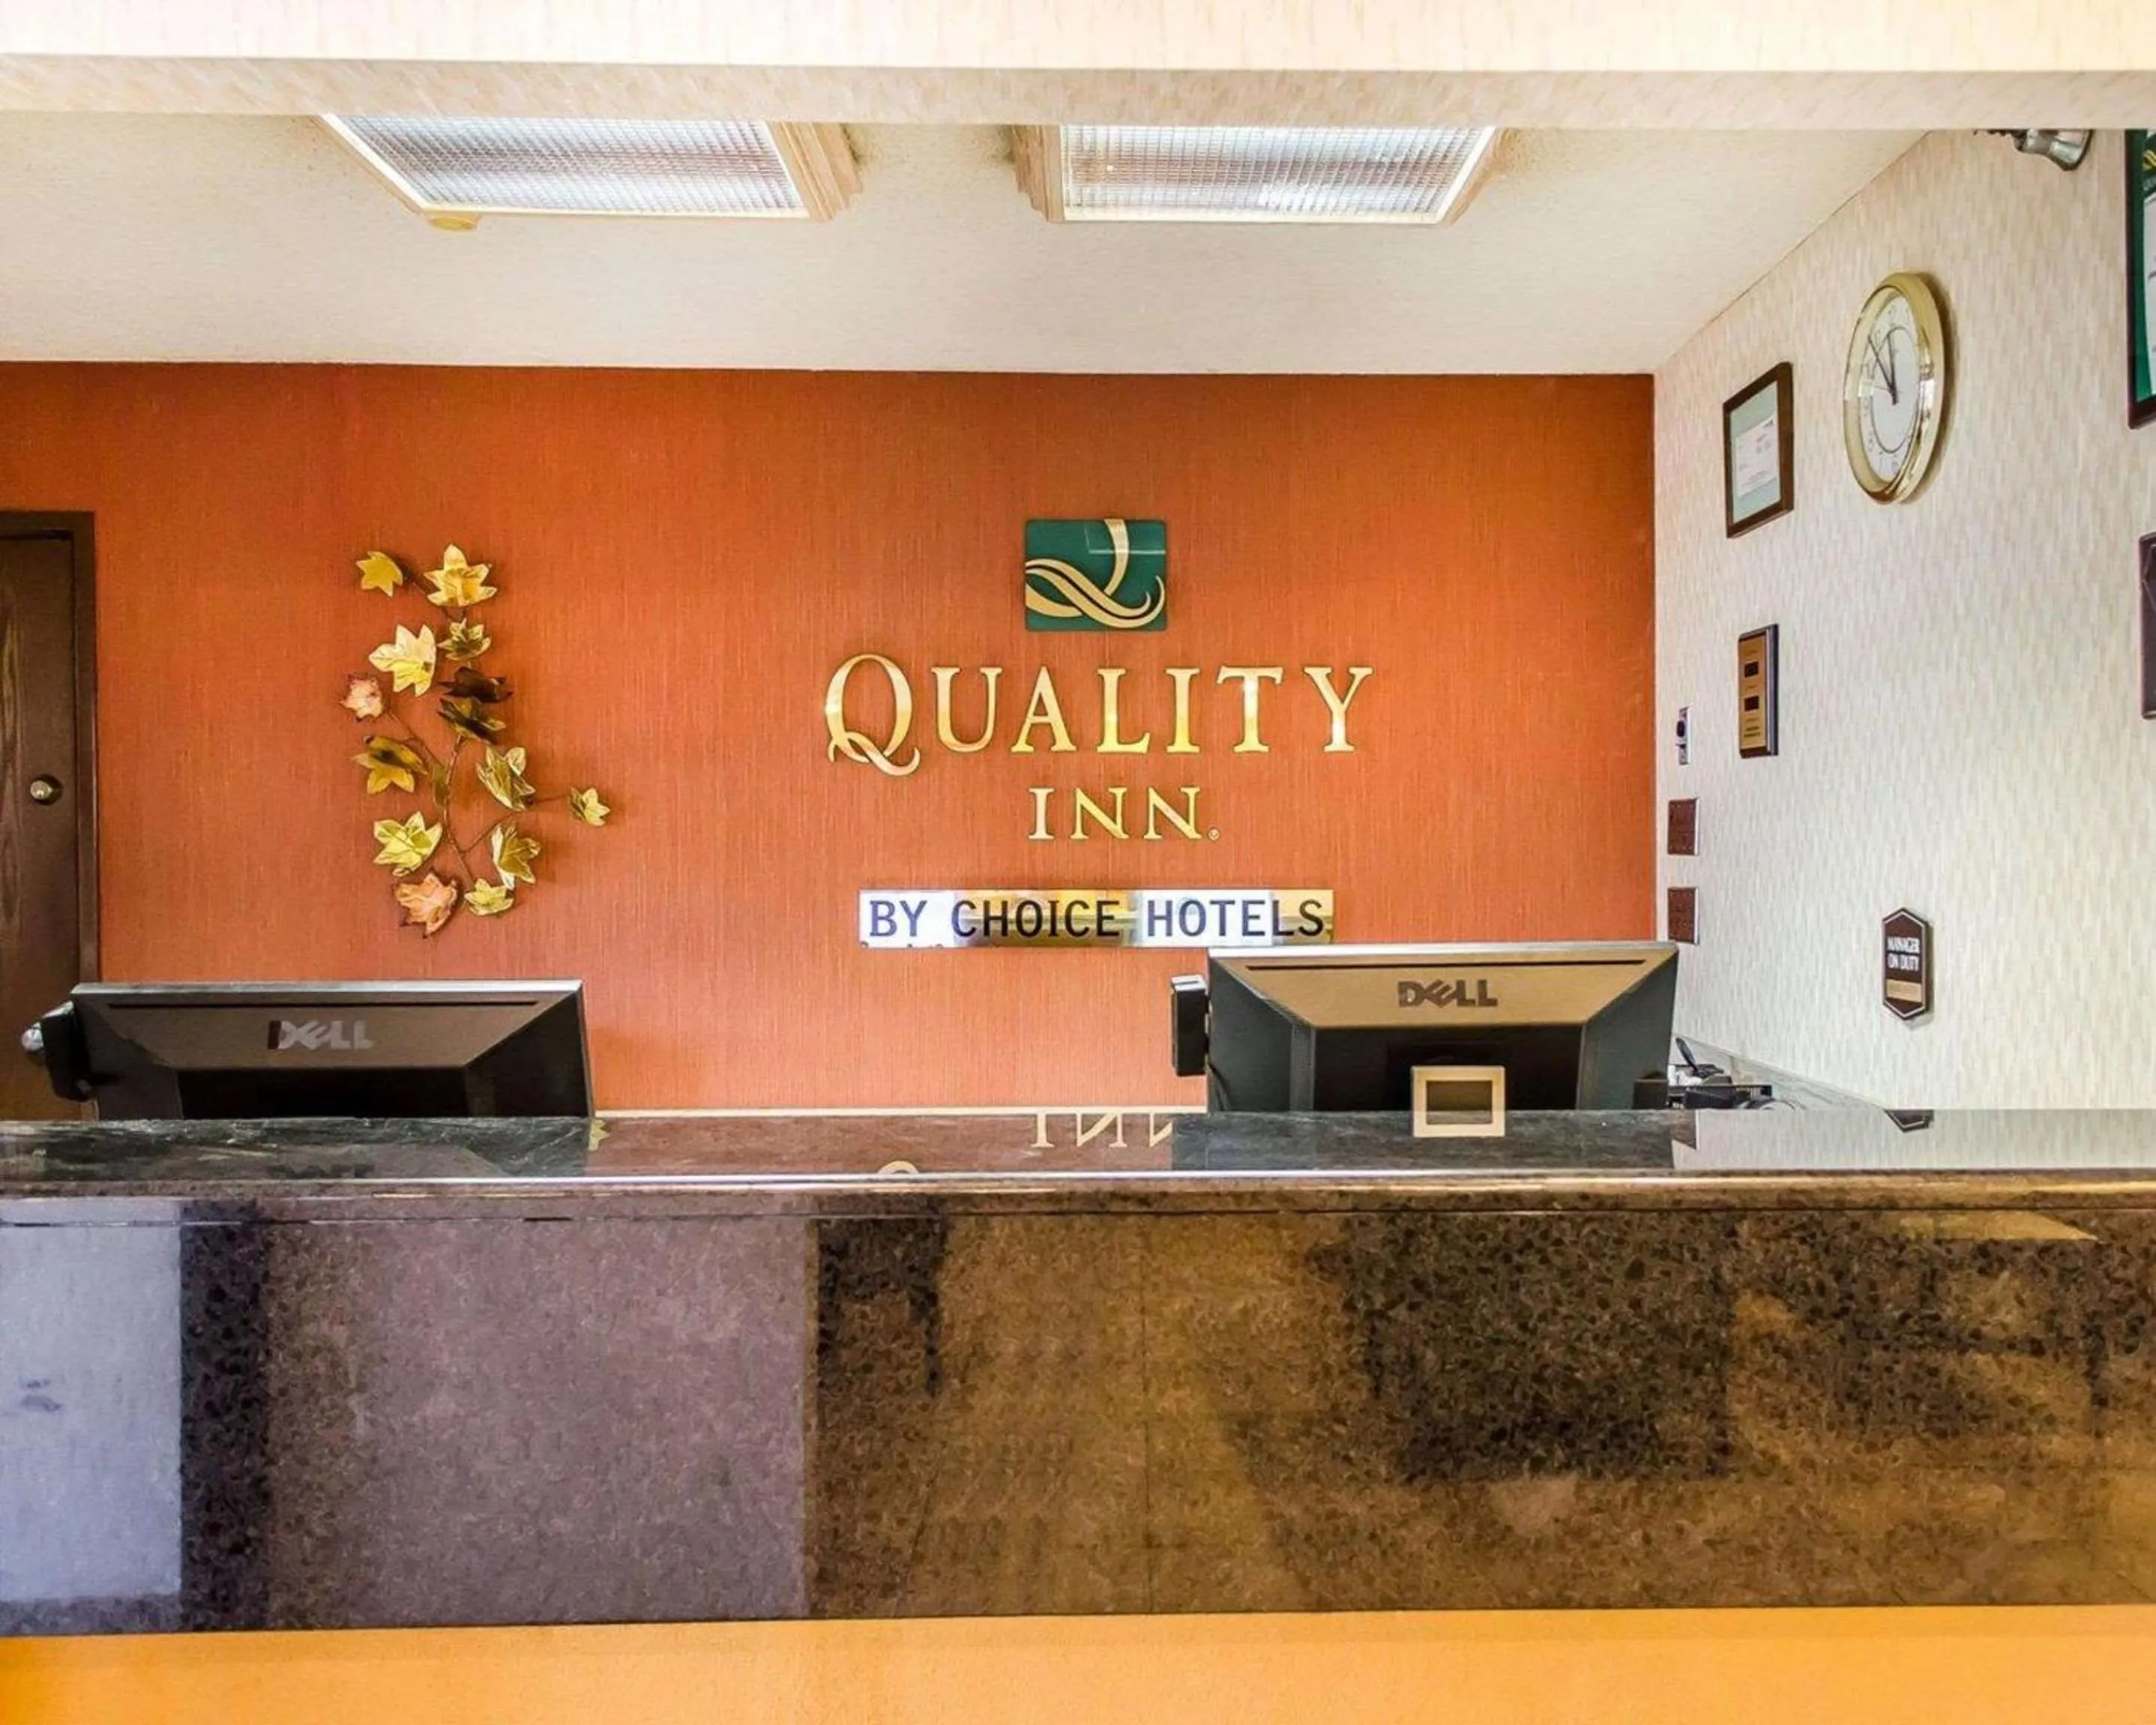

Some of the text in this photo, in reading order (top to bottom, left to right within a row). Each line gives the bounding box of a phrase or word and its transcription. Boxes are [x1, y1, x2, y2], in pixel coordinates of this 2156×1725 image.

[824, 654, 1374, 776] QUALITY
[868, 899, 1324, 939] BY CHOICE HOTELS
[1398, 979, 1498, 1008] DELL
[267, 1020, 374, 1050] DELL
